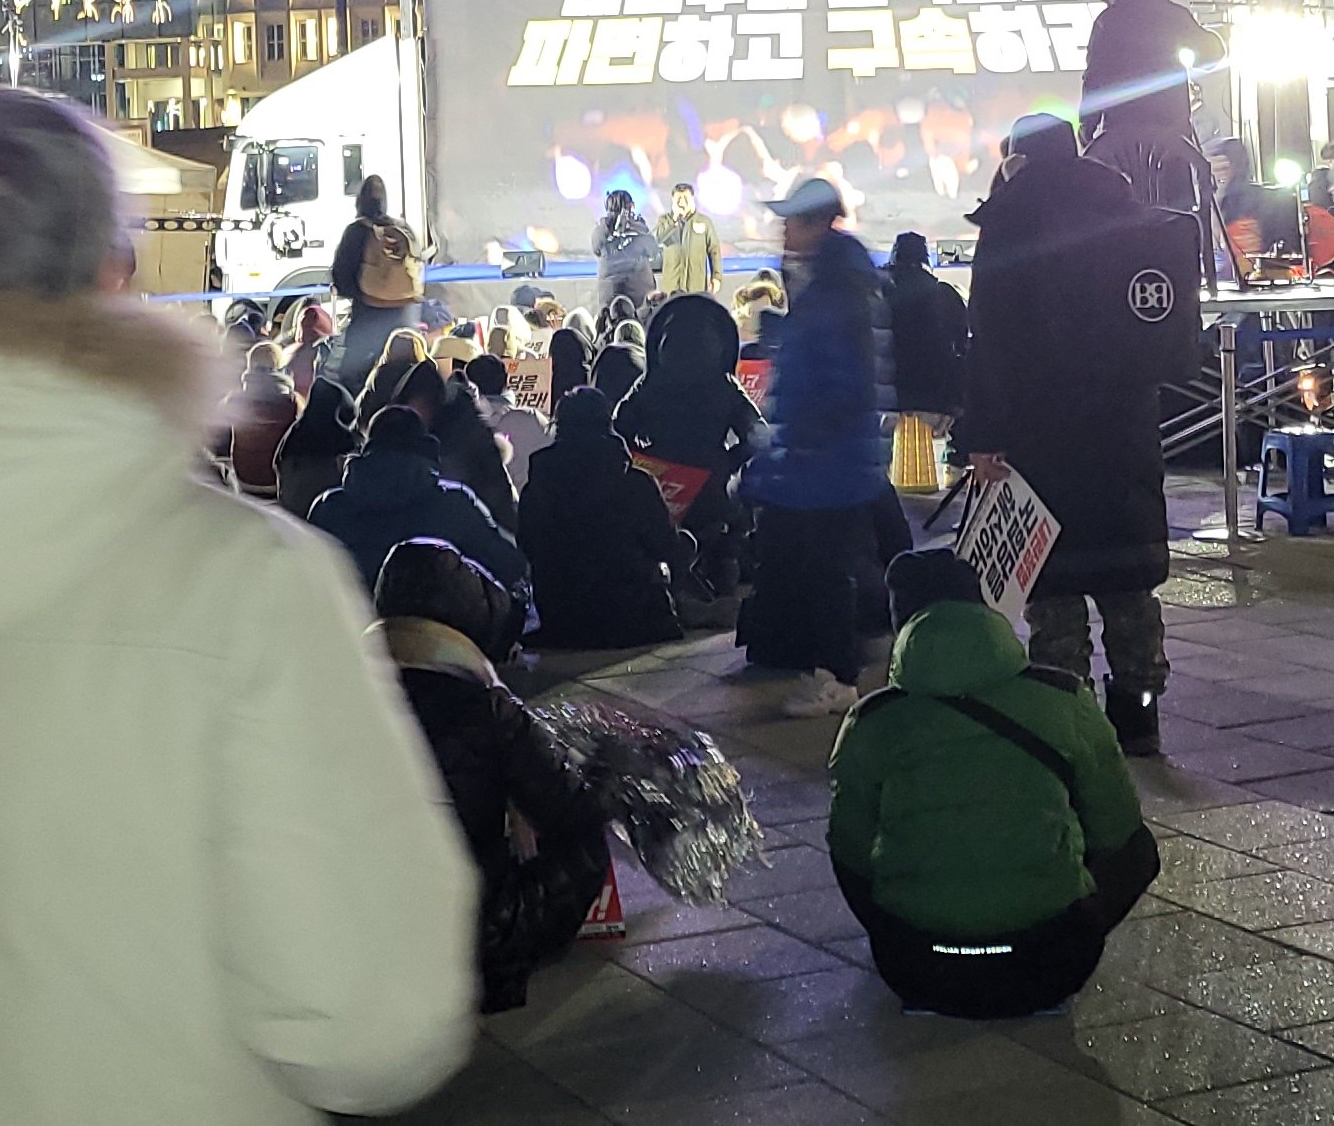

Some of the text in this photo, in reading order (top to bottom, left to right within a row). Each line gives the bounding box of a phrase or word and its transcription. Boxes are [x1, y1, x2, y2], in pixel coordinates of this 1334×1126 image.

[506, 12, 805, 87] 파면하고
[507, 374, 539, 392] 당을
[985, 496, 1039, 604] 국힘당을
